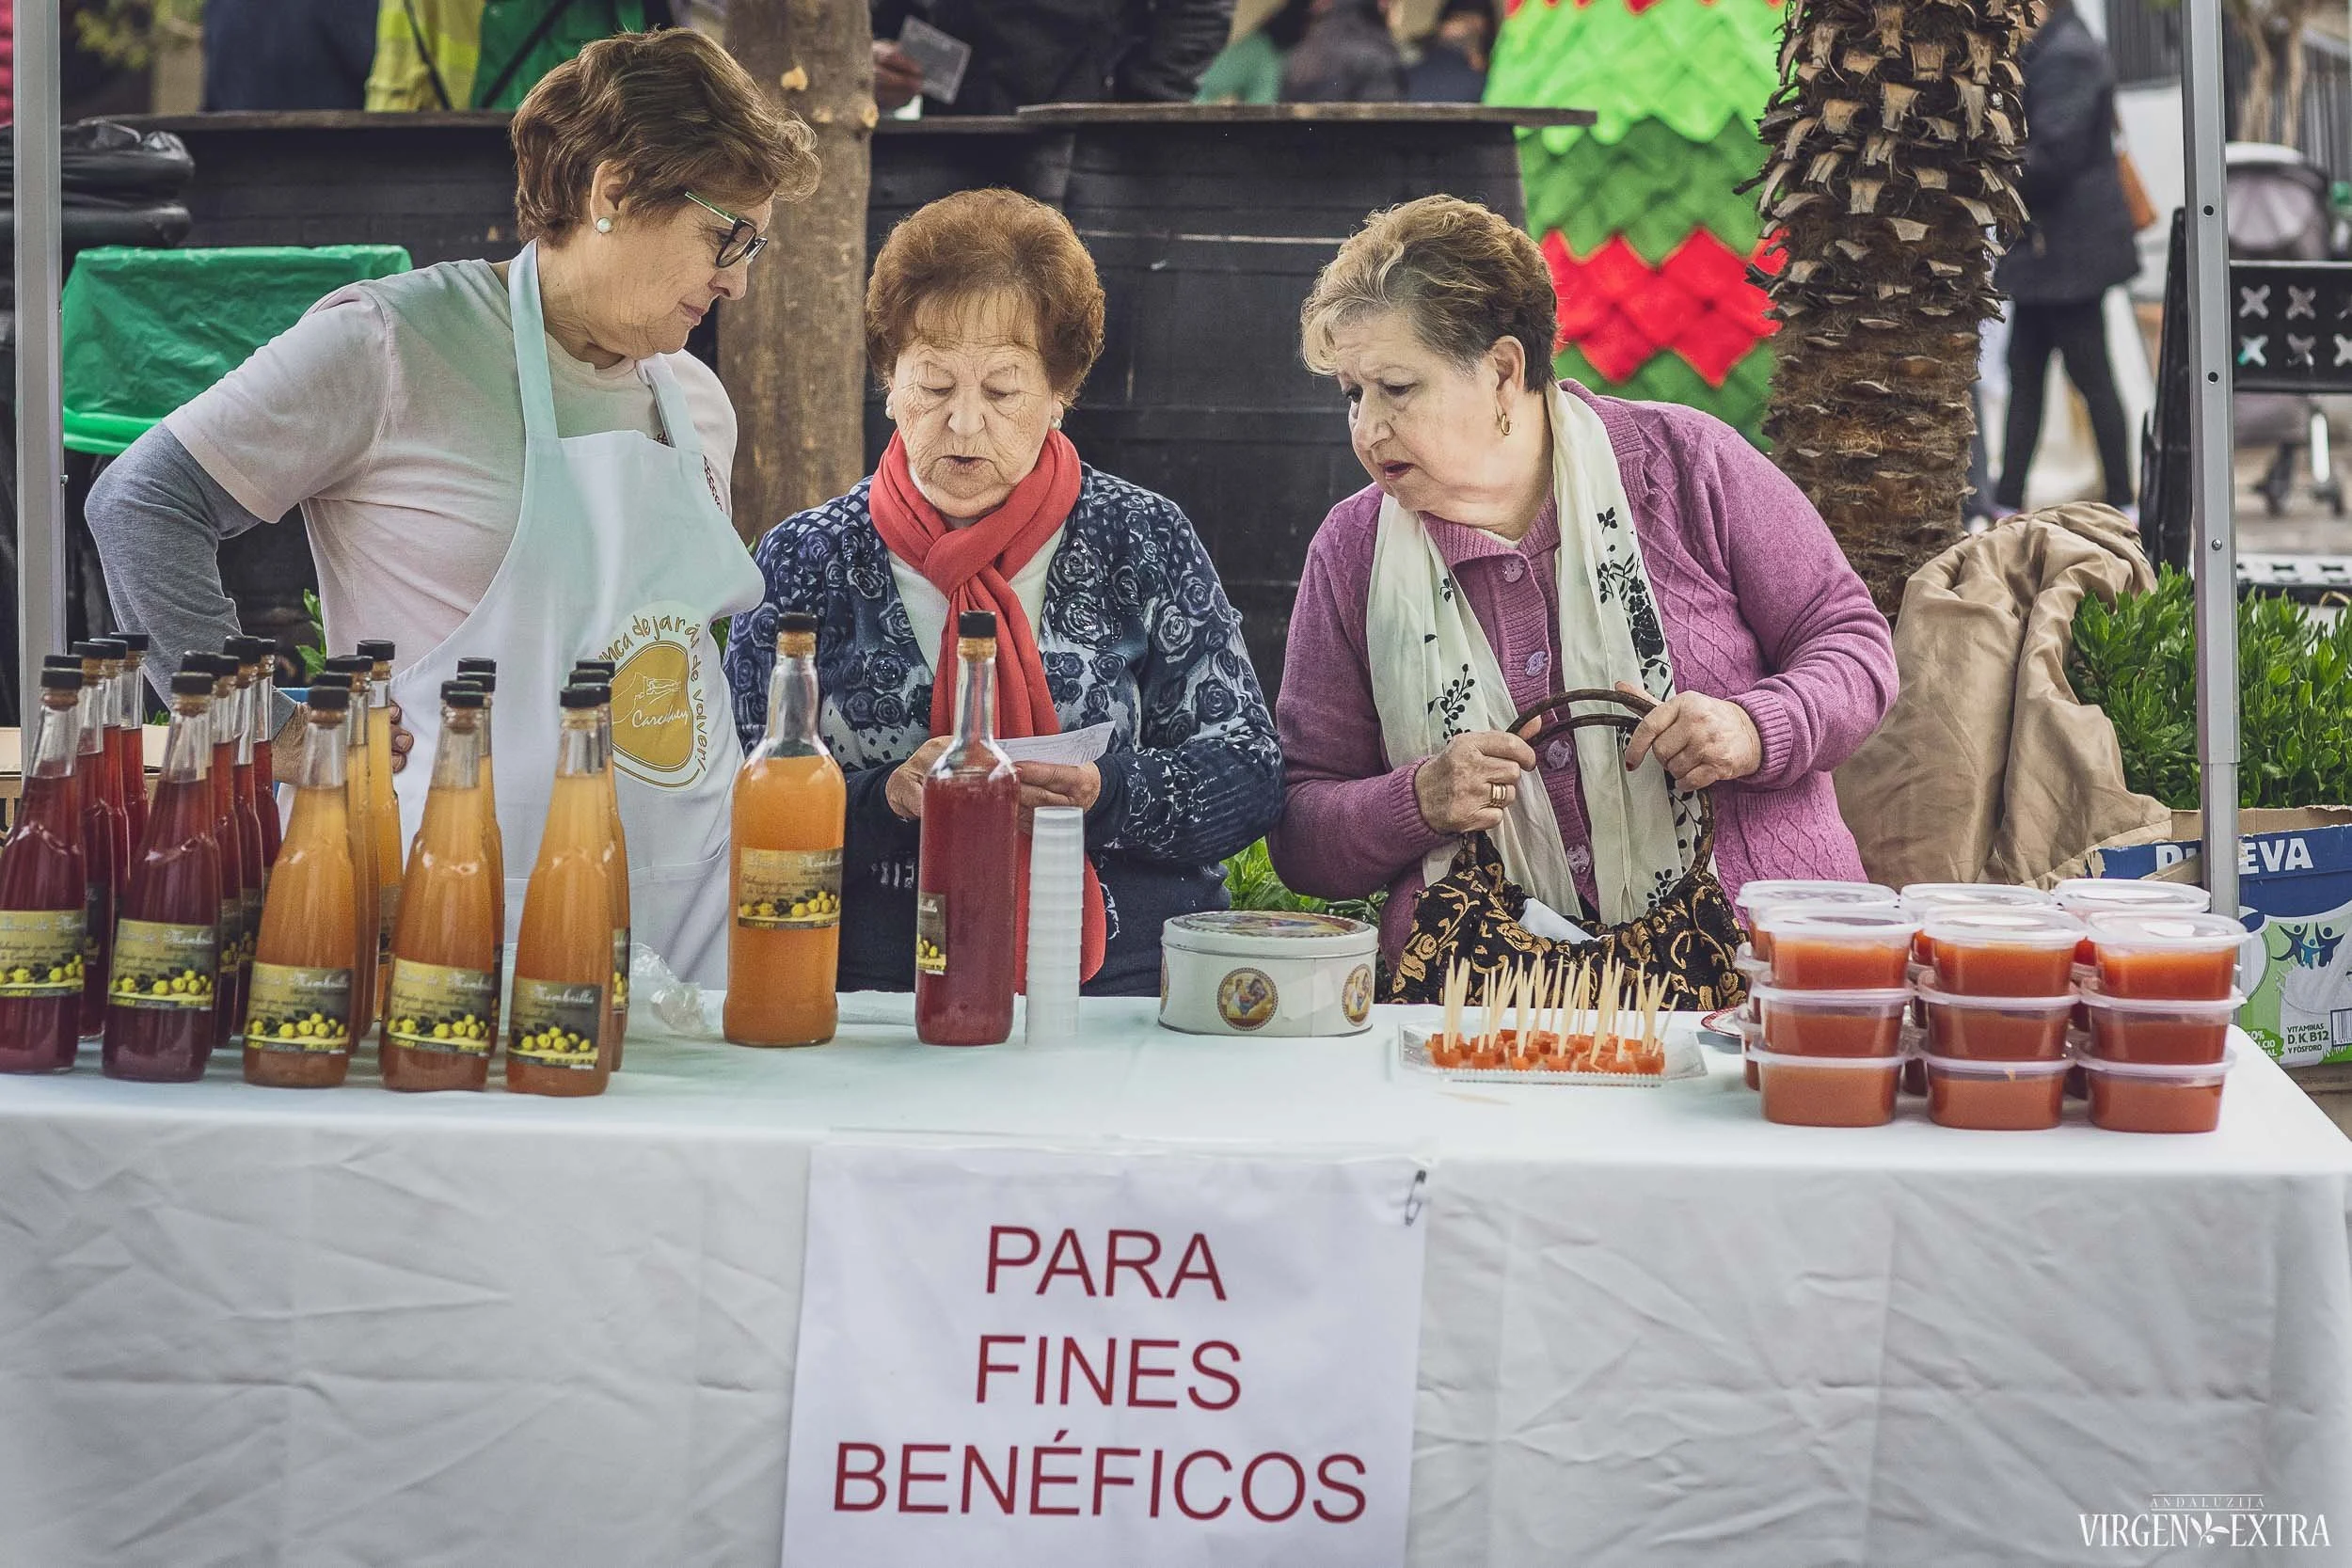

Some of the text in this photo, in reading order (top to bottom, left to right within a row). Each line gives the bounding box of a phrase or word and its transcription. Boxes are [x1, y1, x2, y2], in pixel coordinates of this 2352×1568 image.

[2156, 838, 2313, 874] PEVA
[2286, 1023, 2325, 1034] VITAMINAS
[2310, 1030, 2329, 1042] B12
[986, 1226, 1226, 1301] PARA
[976, 1335, 1241, 1411] FINES
[834, 1429, 1366, 1524] BENÉFICOS
